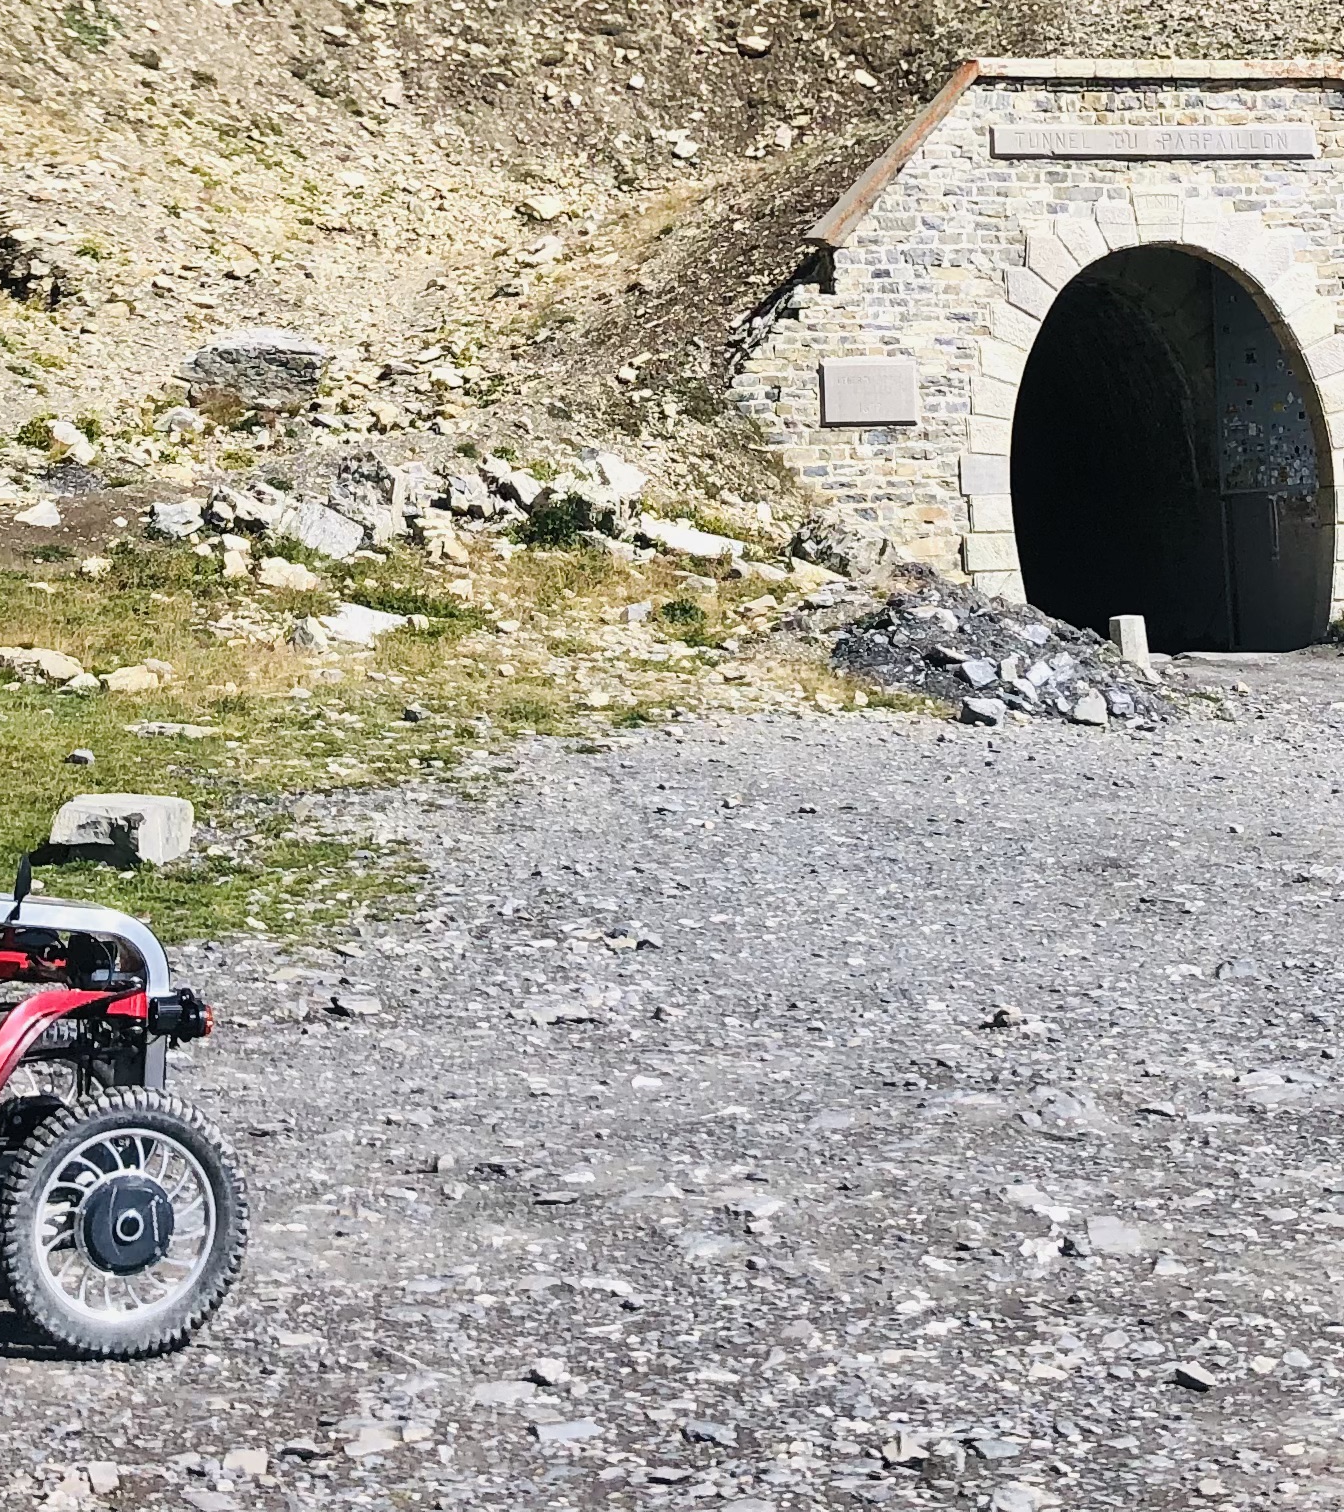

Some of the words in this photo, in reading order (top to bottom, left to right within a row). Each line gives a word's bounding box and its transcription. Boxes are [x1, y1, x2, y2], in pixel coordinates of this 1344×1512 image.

[1014, 131, 1092, 150] TUNNEL
[1112, 131, 1138, 149] DU
[1160, 131, 1289, 150] PARPAILLON
